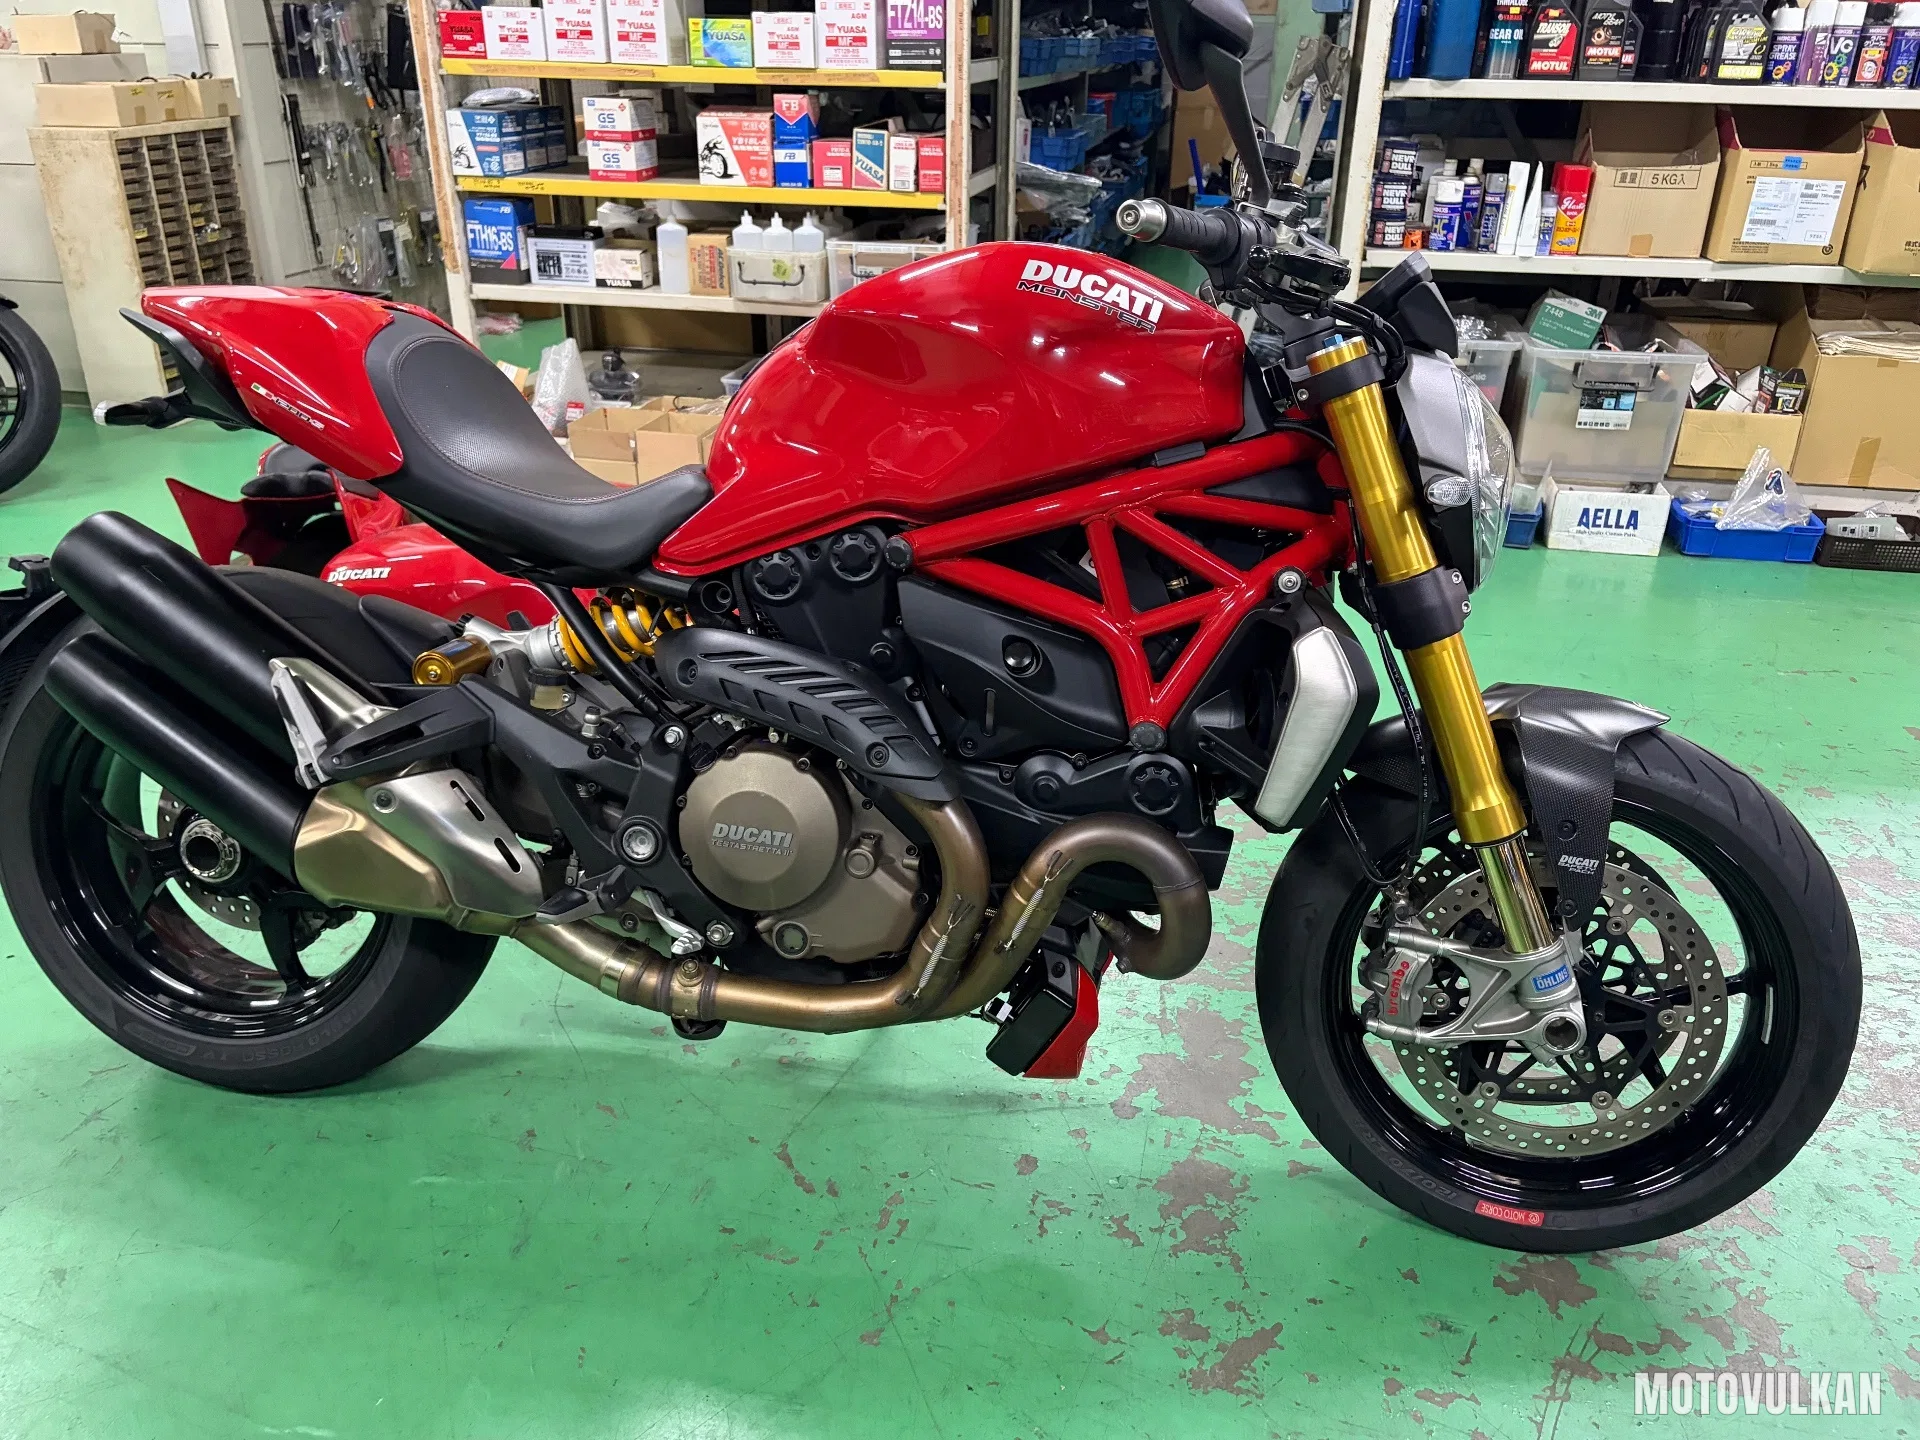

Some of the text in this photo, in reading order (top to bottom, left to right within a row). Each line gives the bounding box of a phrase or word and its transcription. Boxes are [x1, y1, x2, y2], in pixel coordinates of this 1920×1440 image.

[888, 0, 943, 29] FTZ14-BS
[565, 20, 592, 28] YUASA
[628, 22, 655, 30] YUASA
[836, 25, 867, 34] YUASA
[567, 30, 580, 39] MF
[628, 32, 643, 41] MF
[708, 31, 746, 41] YUASA
[1489, 28, 1512, 40] GEAR
[838, 36, 853, 46] MF
[1587, 46, 1620, 57] MOTUL
[1772, 44, 1797, 52] SPRAY
[1768, 52, 1798, 60] GREASE
[1529, 60, 1569, 71] MOTUL
[782, 100, 799, 110] FB
[598, 113, 616, 123] GS
[603, 153, 620, 163] GS
[783, 152, 797, 160] FB
[855, 156, 884, 184] YUASA
[1391, 162, 1412, 171] DULL
[1383, 197, 1405, 206] DULL
[500, 206, 511, 214] FB
[467, 223, 514, 252] FTH16-BS
[605, 280, 632, 288] YUASA
[1021, 259, 1164, 324] DUCATI
[1016, 281, 1156, 334] MONSTER
[1544, 305, 1565, 318] 7448
[1585, 306, 1603, 320] 3M
[1577, 507, 1639, 530] AELLA
[327, 566, 392, 583] DUCATI
[712, 822, 794, 848] DUCATI
[711, 839, 783, 856] TESTASTRETTA
[1559, 854, 1600, 868] DUCATI
[1536, 967, 1569, 990] ÖHLINS
[1387, 960, 1411, 1016] brembo
[1481, 1203, 1525, 1222] MOTO CORSE
